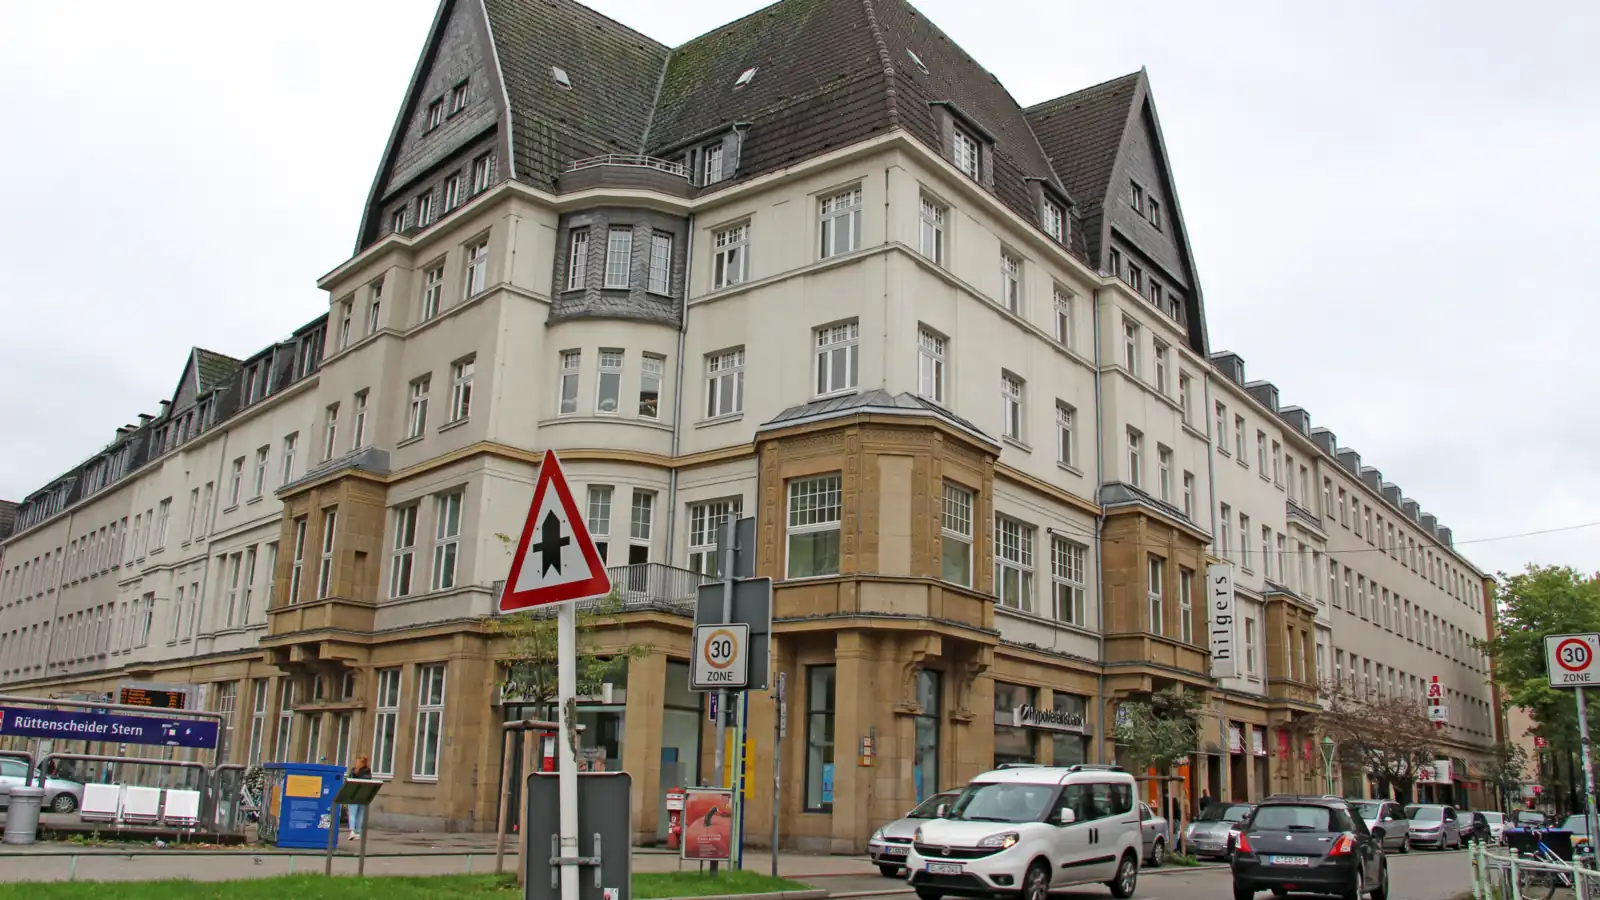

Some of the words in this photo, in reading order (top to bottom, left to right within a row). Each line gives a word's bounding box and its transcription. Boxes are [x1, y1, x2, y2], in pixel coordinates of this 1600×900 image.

[1213, 576, 1232, 660] hilgers
[711, 640, 731, 658] 30
[1563, 647, 1585, 663] 30
[707, 671, 734, 682] ZONE
[1563, 672, 1591, 682] ZONE
[14, 716, 108, 733] Rüttenscheider
[111, 722, 143, 736] Stern
